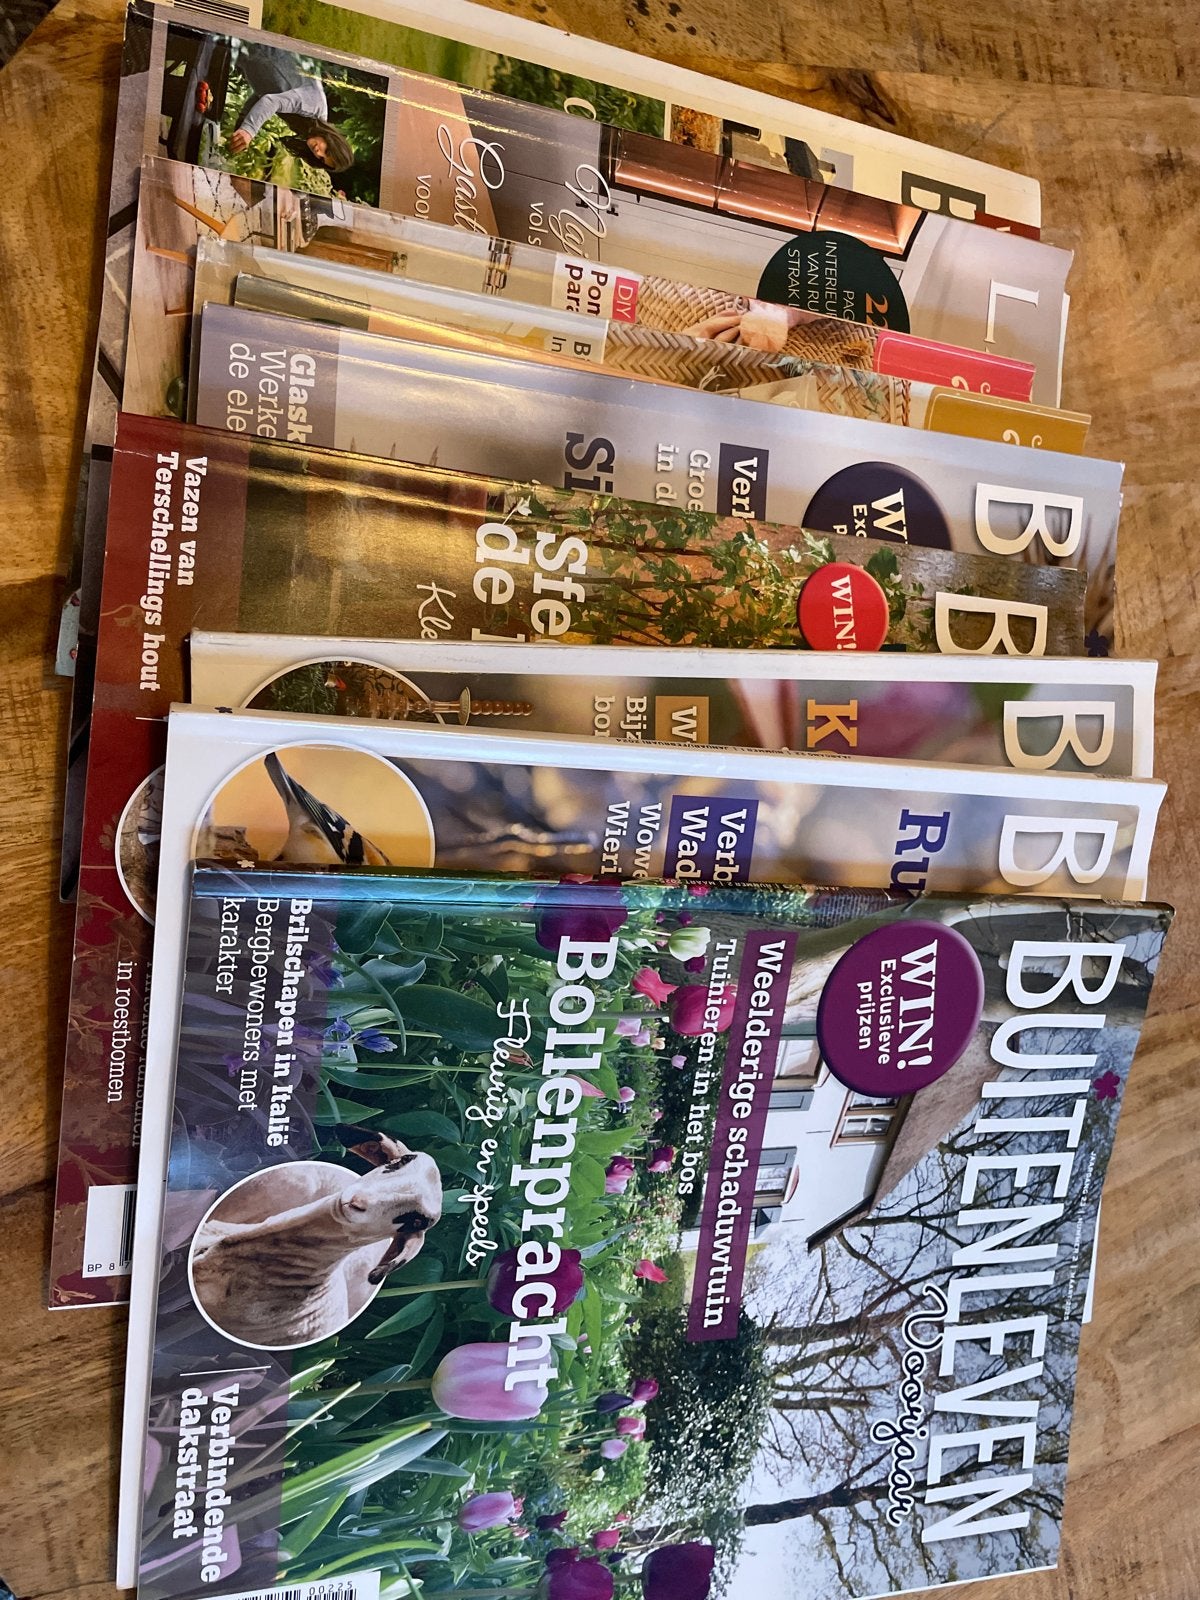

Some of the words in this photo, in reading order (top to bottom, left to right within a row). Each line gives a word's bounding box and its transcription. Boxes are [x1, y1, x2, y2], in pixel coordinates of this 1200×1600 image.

[527, 235, 541, 245] s
[528, 202, 548, 232] vol
[616, 284, 634, 319] DIY
[787, 248, 801, 300] STRAK
[807, 252, 820, 286] VAN
[984, 279, 1040, 344] L
[228, 342, 256, 380] de
[286, 353, 317, 443] Glask
[655, 443, 680, 473] in
[179, 456, 208, 532] Vazen
[870, 487, 909, 545] W
[139, 451, 179, 625] Terschellings
[175, 540, 198, 586] van
[472, 522, 530, 606] de
[529, 531, 589, 645] Sfe
[829, 574, 858, 651] WIN!
[138, 633, 166, 691] hout
[670, 706, 697, 744] W
[806, 699, 858, 758] K
[600, 800, 631, 874] Wieri
[998, 814, 1119, 887] B
[115, 961, 138, 982] in
[216, 896, 246, 995] karakter
[276, 898, 313, 1047] Brilschapen
[242, 898, 280, 1061] Bergbewoners
[696, 938, 737, 1063] Tuinieren
[871, 958, 897, 1065] Exclusieve
[896, 939, 938, 1070] WIN!
[106, 988, 132, 1104] roestbomen
[729, 939, 786, 1120] Weelderige
[856, 981, 876, 1050] prijzen
[237, 1069, 260, 1111] met
[274, 1053, 296, 1078] in
[464, 998, 533, 1128] Fleurig
[693, 1071, 713, 1098] in
[266, 1084, 294, 1147] Italië
[684, 1104, 708, 1144] het
[478, 1138, 498, 1175] en
[507, 935, 619, 1390] Bollenpracht
[677, 1151, 701, 1195] bos
[1081, 1150, 1097, 1194] JAARGANG
[458, 1183, 500, 1268] speels
[703, 1127, 751, 1328] schaduwtuin
[922, 940, 1126, 1543] BUITENLEVEN
[1072, 1217, 1083, 1254] NUMMER
[87, 1263, 102, 1273] BP
[109, 1262, 115, 1271] 8
[1066, 1272, 1076, 1299] MAART
[870, 1285, 948, 1526] Voorjaar
[173, 1387, 208, 1540] dakstraat
[200, 1382, 240, 1583] Verbindende
